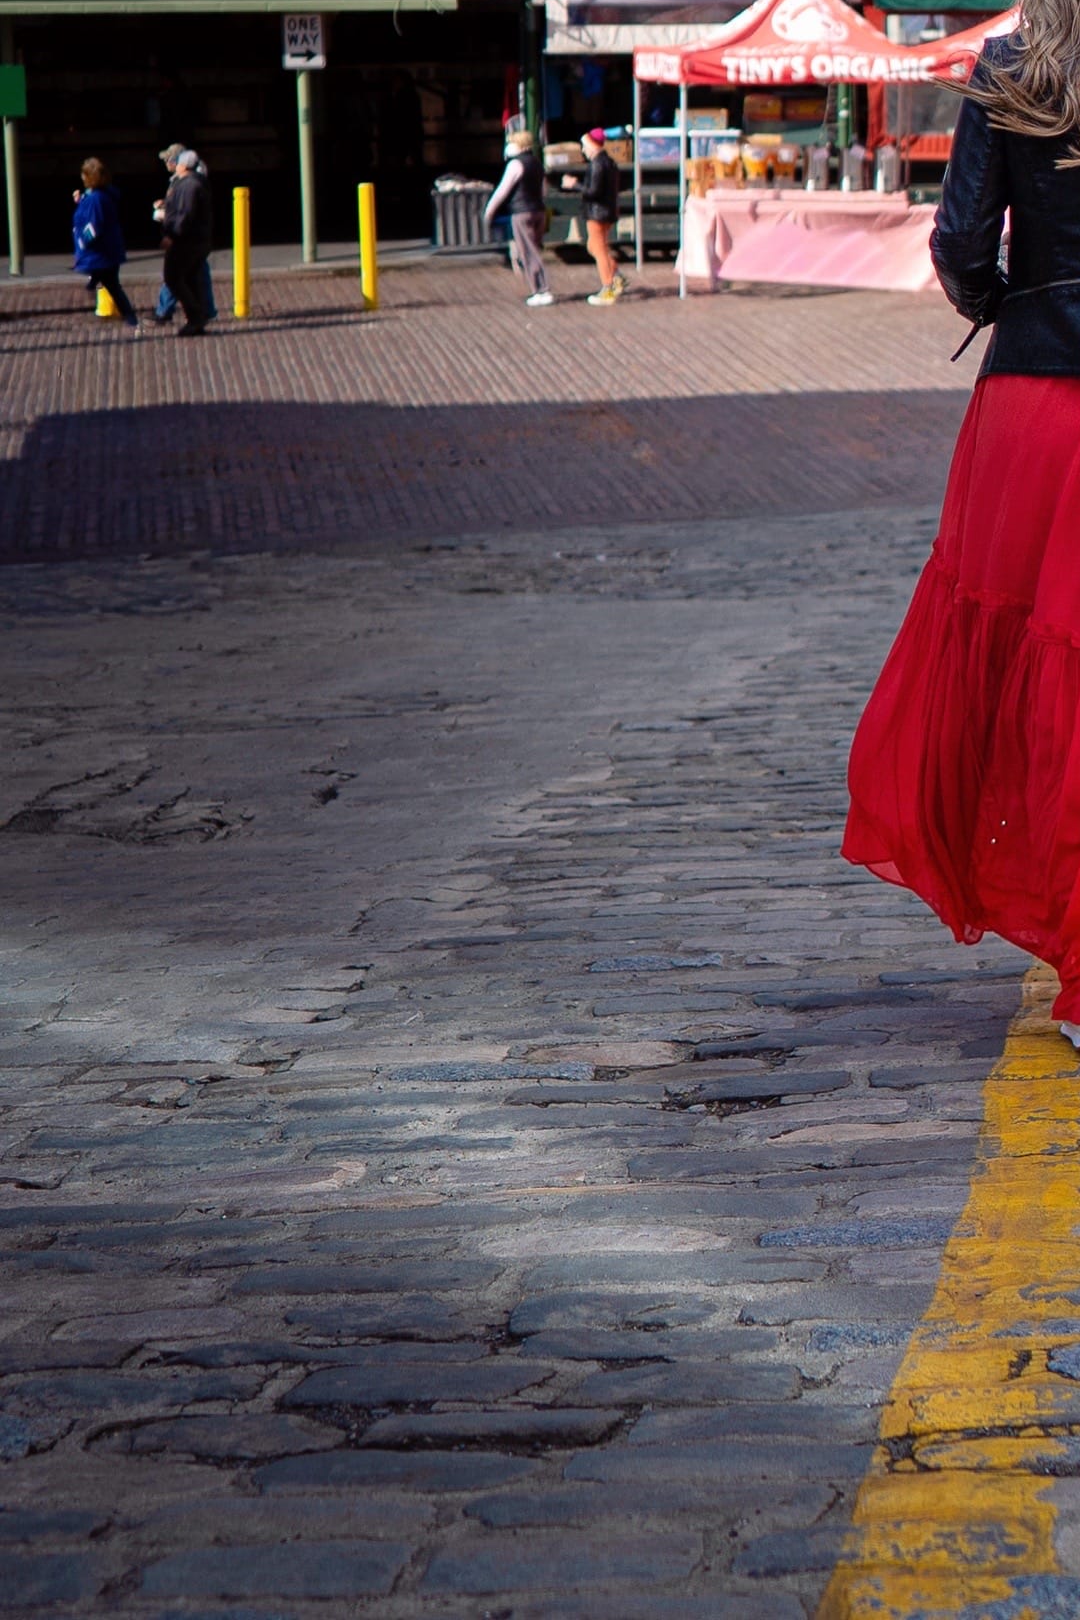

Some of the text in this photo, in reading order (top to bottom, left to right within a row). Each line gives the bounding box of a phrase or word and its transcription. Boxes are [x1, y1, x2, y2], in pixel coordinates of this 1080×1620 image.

[287, 17, 318, 31] ONE
[287, 32, 320, 47] WAY
[720, 53, 937, 84] TINY'S ORGANIC
